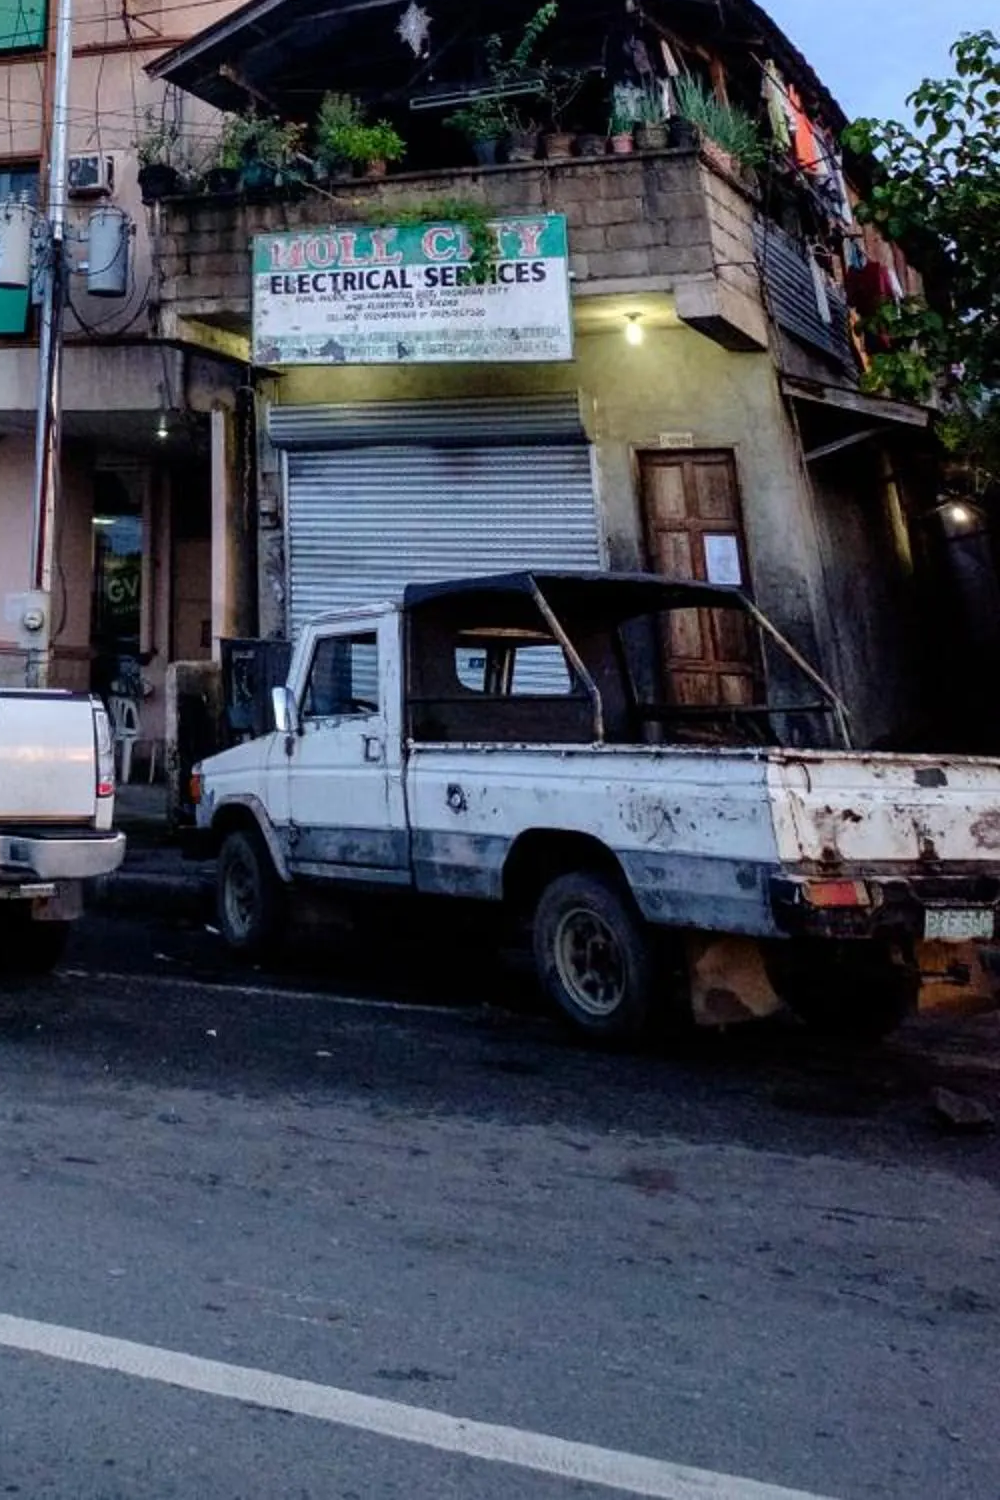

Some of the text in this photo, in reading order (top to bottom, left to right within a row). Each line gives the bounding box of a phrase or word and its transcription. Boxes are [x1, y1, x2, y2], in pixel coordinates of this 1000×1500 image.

[270, 227, 403, 269] MOLL
[270, 268, 413, 295] ELECTRICAL
[108, 575, 139, 602] GV
